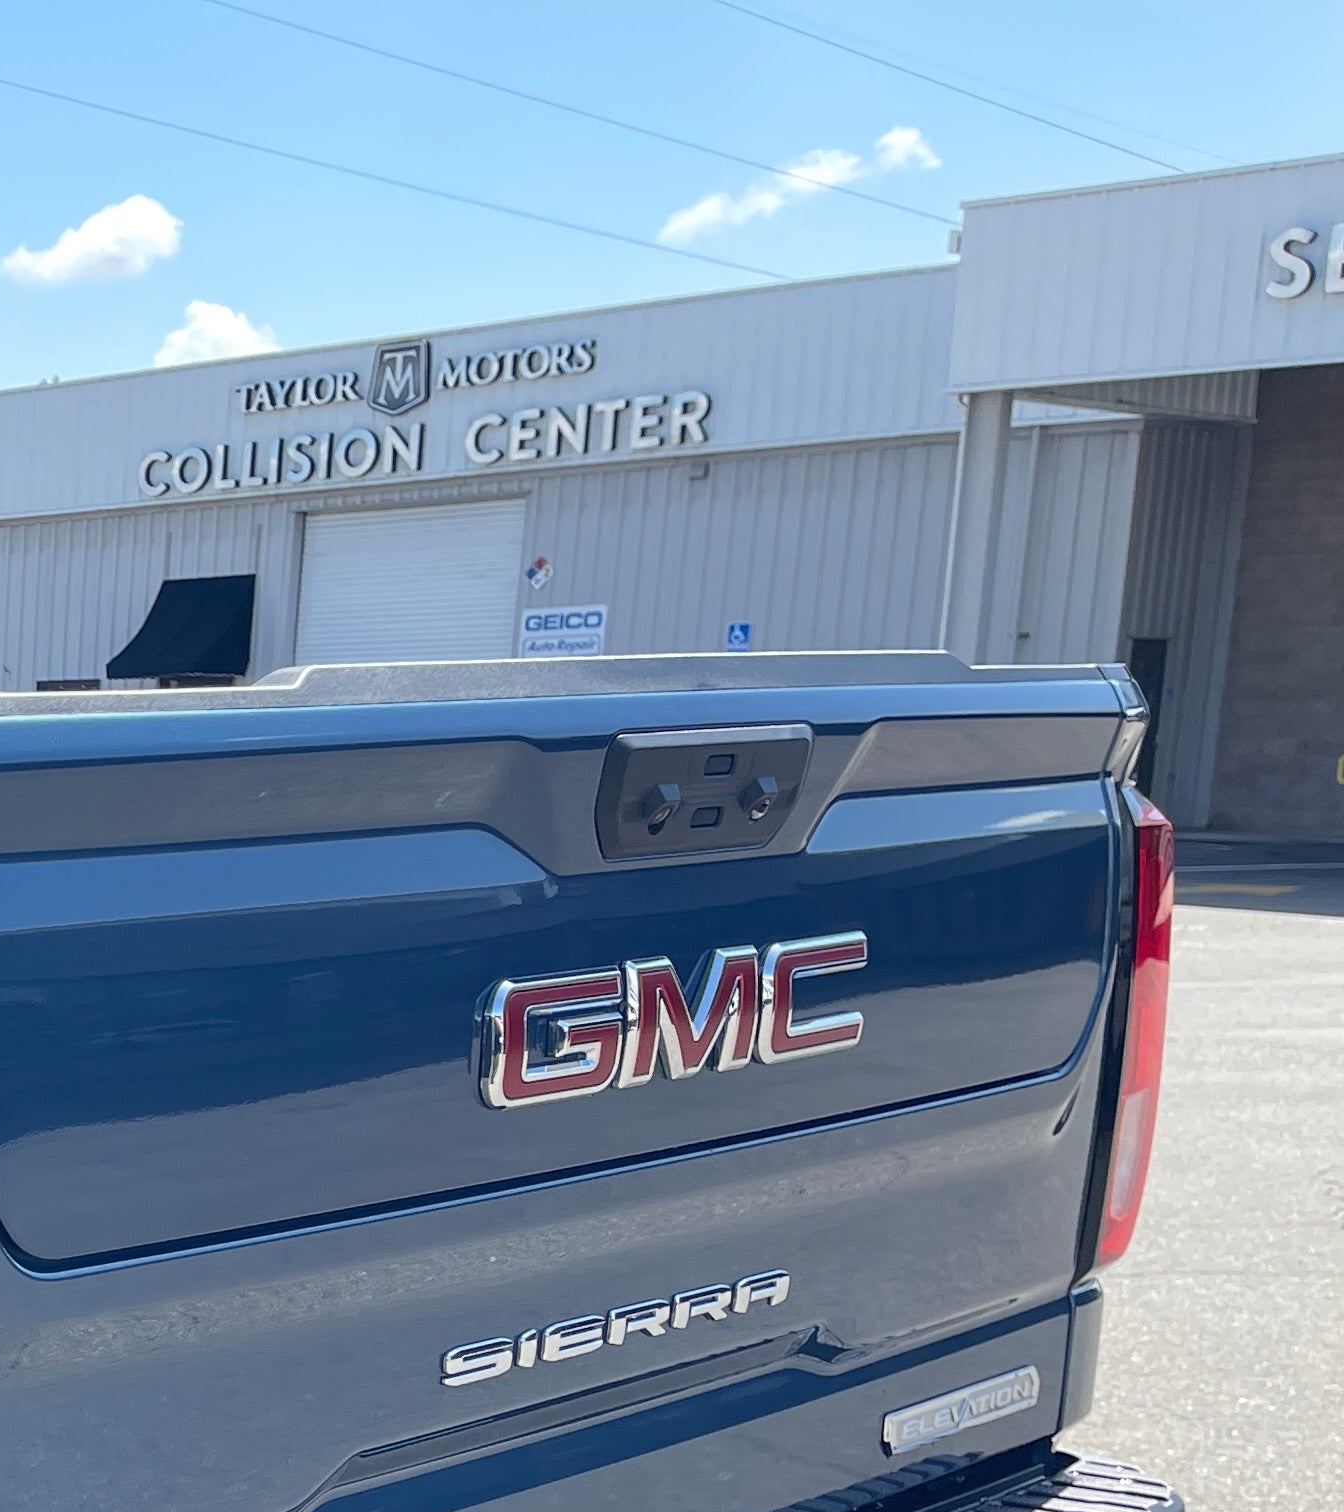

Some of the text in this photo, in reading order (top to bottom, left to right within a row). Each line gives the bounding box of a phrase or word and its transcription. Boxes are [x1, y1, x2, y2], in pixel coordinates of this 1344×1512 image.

[235, 370, 362, 414] TAYLOR
[436, 339, 597, 390] MOTORS
[138, 390, 711, 496] COLLISION CENTER
[525, 611, 603, 631] GEICO
[475, 930, 868, 1108] GMC
[440, 1269, 791, 1387] SIERRA
[901, 1379, 1033, 1440] ELEVATION
